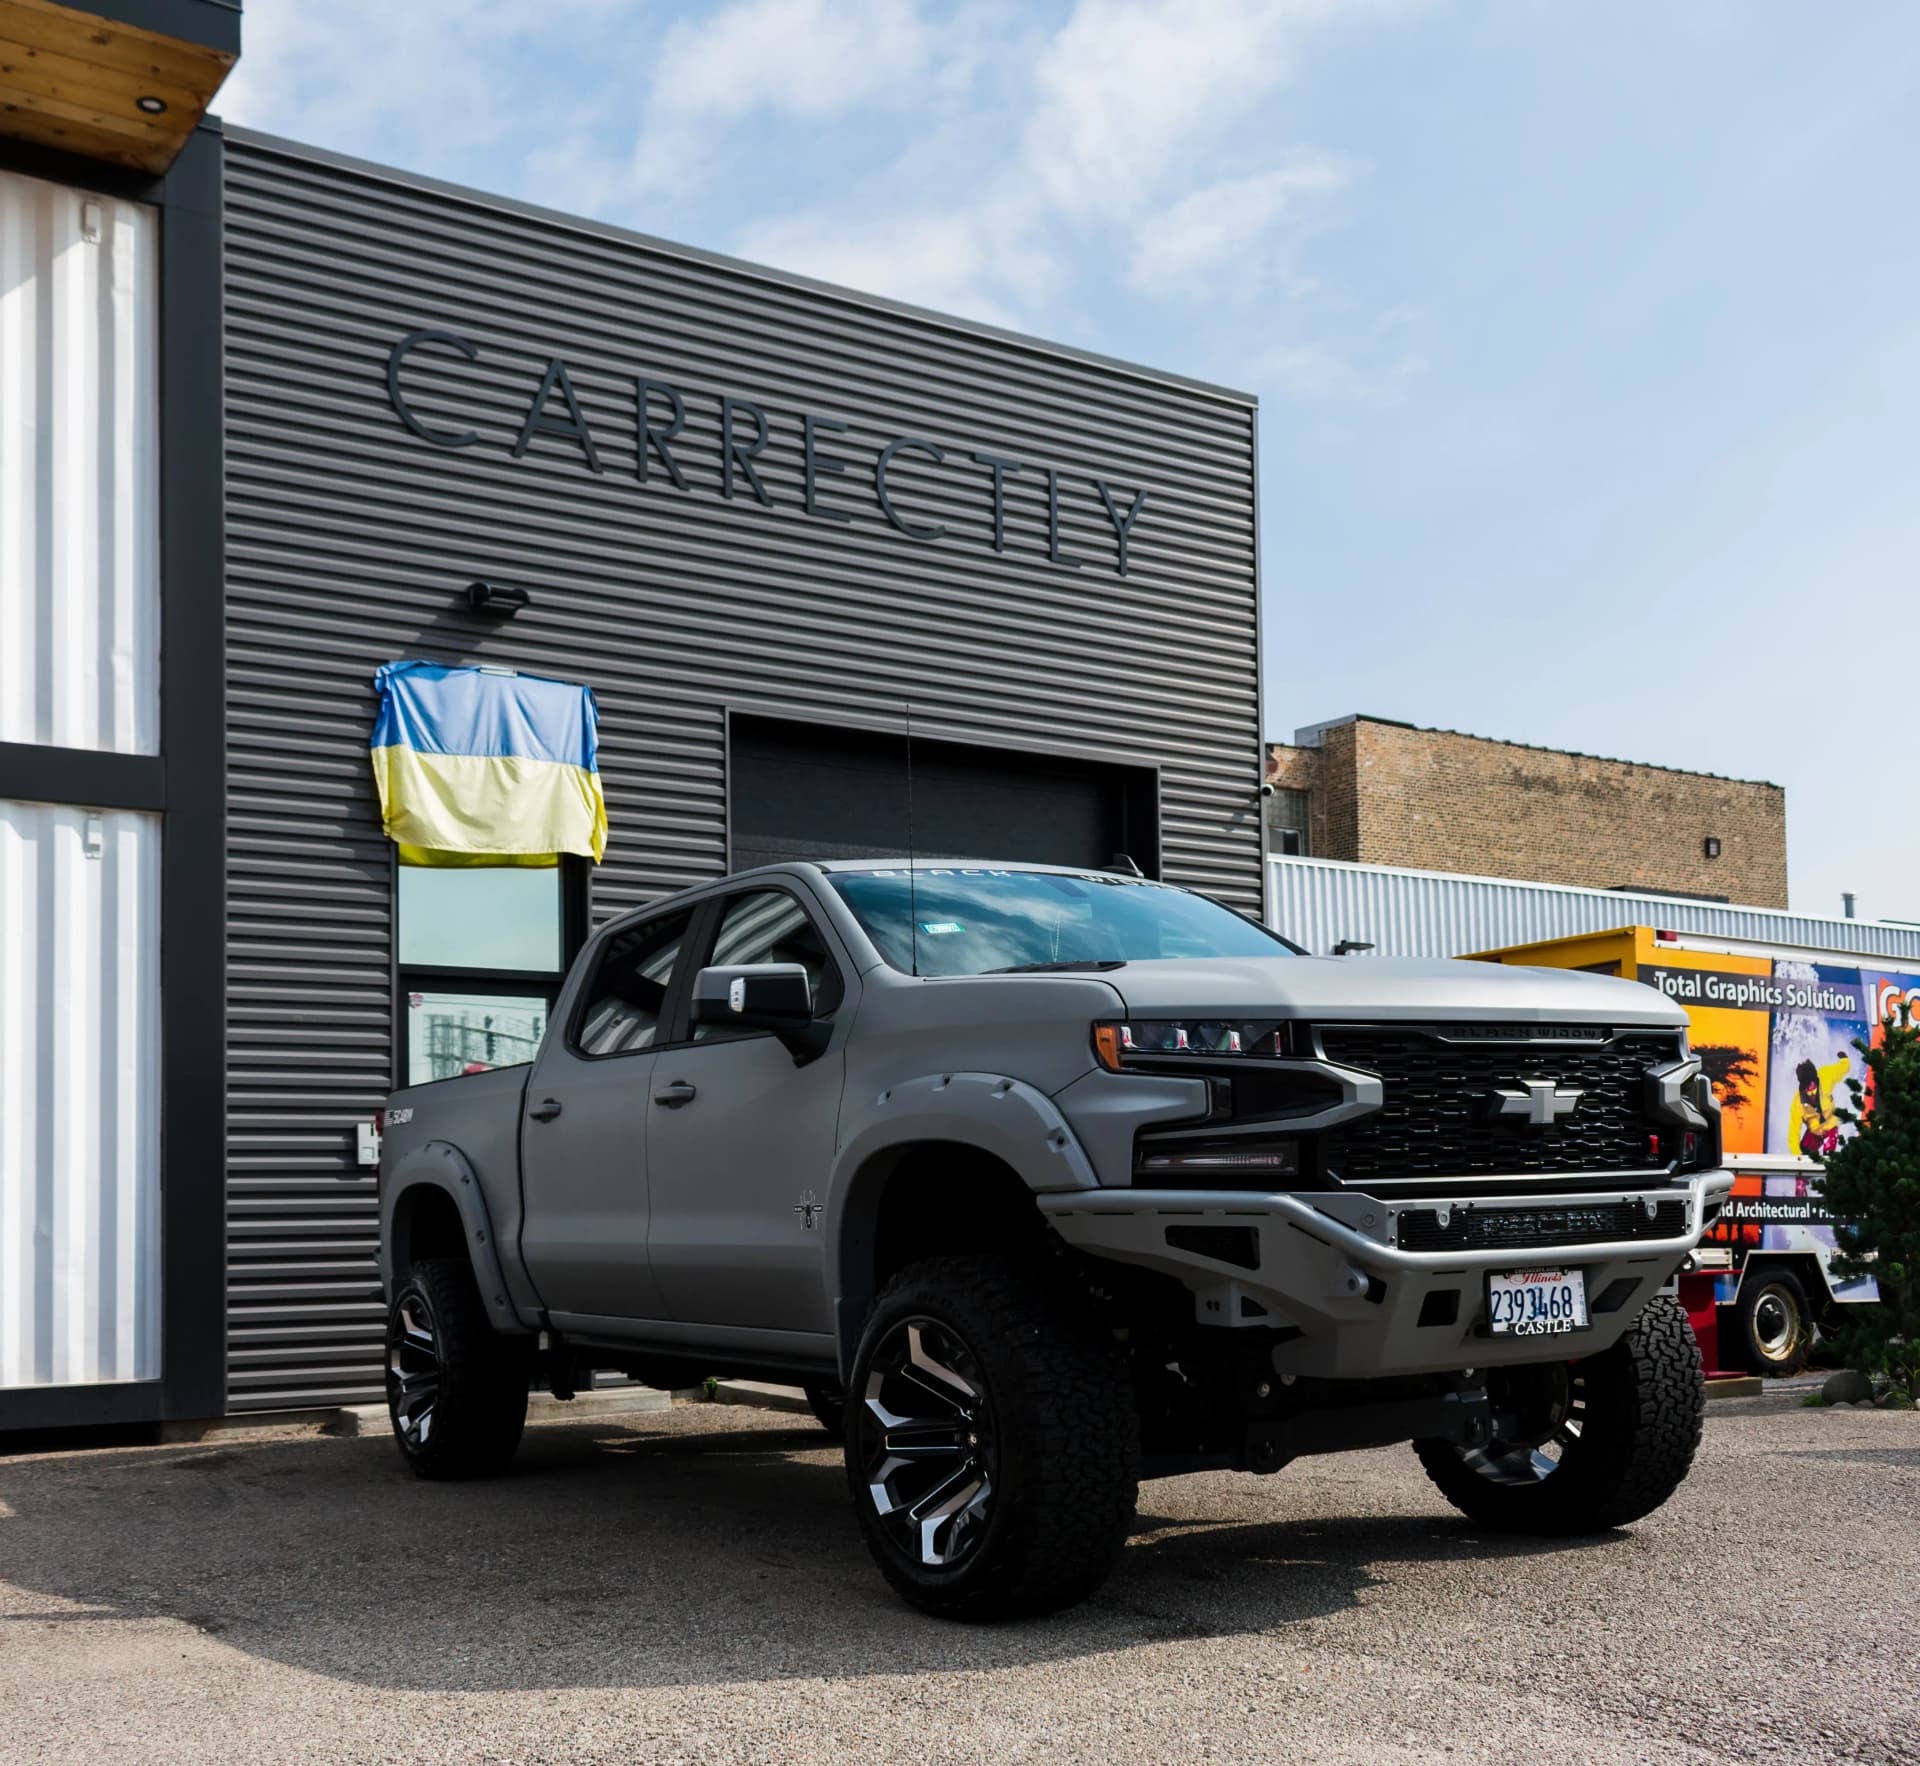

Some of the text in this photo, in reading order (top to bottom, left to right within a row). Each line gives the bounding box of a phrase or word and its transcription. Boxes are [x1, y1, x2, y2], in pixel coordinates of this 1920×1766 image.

[386, 330, 1148, 576] CARRECTLY
[1655, 971, 1856, 1012] Total Graphics Solution
[1537, 1029, 1595, 1038] WIDOW
[1736, 1201, 1810, 1218] Architectural
[1509, 1272, 1563, 1285] Illinois
[1491, 1286, 1573, 1323] 2393468
[1515, 1319, 1573, 1335] CASTLE
